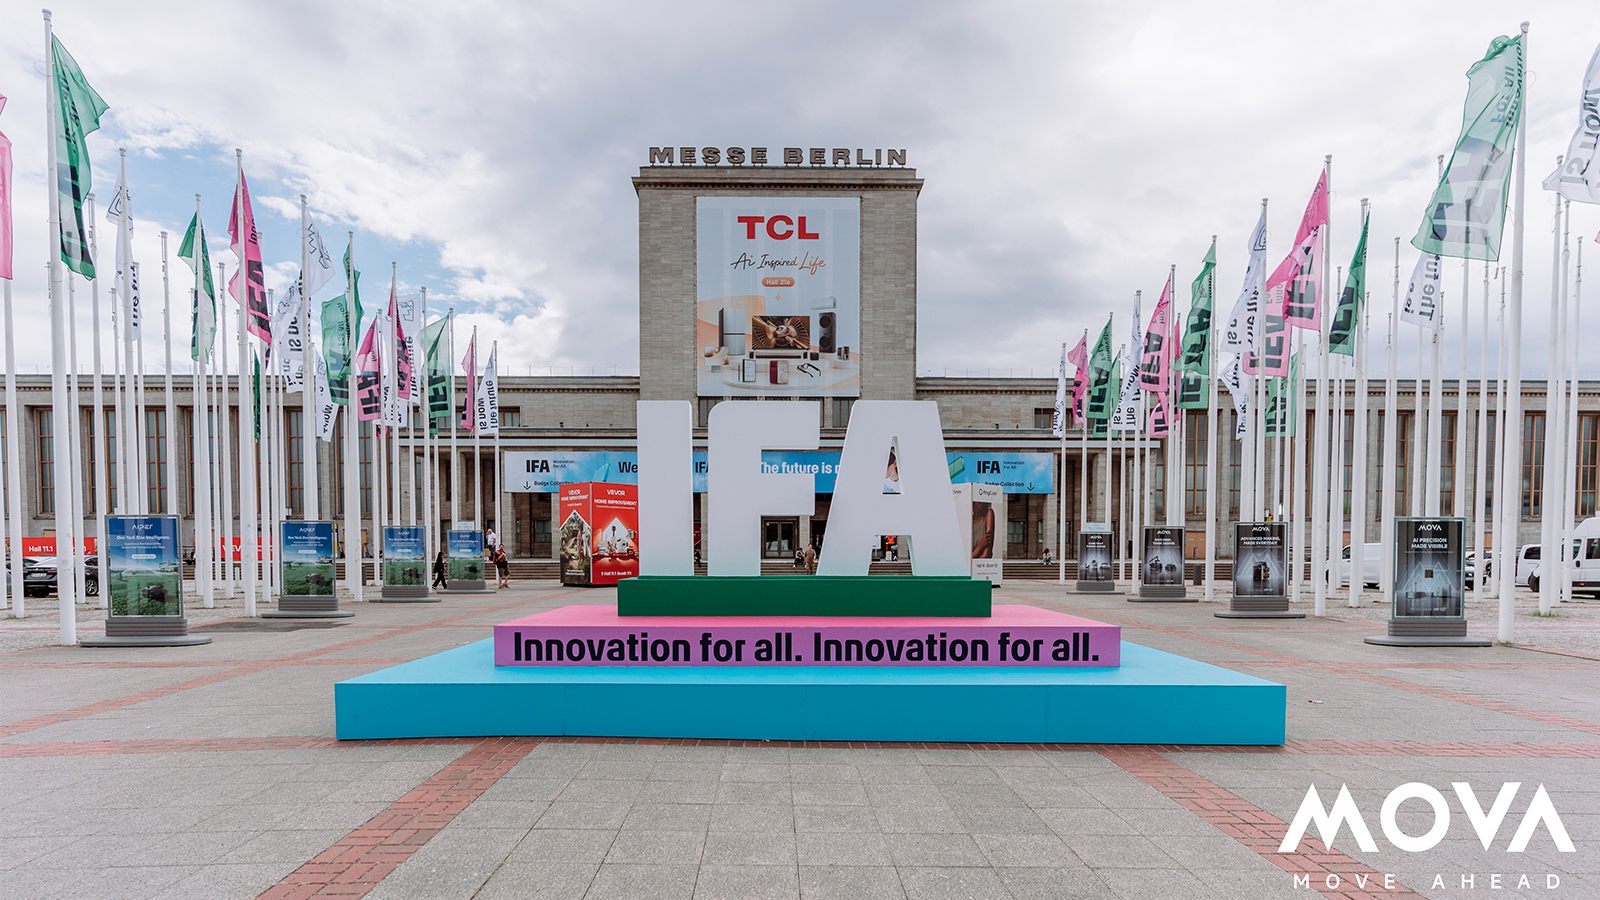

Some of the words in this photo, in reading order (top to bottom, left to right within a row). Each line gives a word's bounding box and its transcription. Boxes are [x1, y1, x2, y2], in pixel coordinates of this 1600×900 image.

[650, 146, 768, 164] MESSE
[784, 148, 906, 166] BERLIN
[737, 214, 820, 240] TCL
[757, 254, 798, 270] Inspired
[798, 252, 826, 276] Life
[526, 460, 550, 473] IFA
[781, 461, 819, 474] future
[821, 461, 832, 474] is
[977, 460, 1001, 474] IFA
[637, 400, 972, 577] IFA
[514, 631, 692, 662] Innovation
[700, 631, 746, 662] for
[754, 631, 802, 662] all.
[812, 631, 992, 662] Innovation
[998, 631, 1044, 662] for
[1052, 631, 1100, 662] all.
